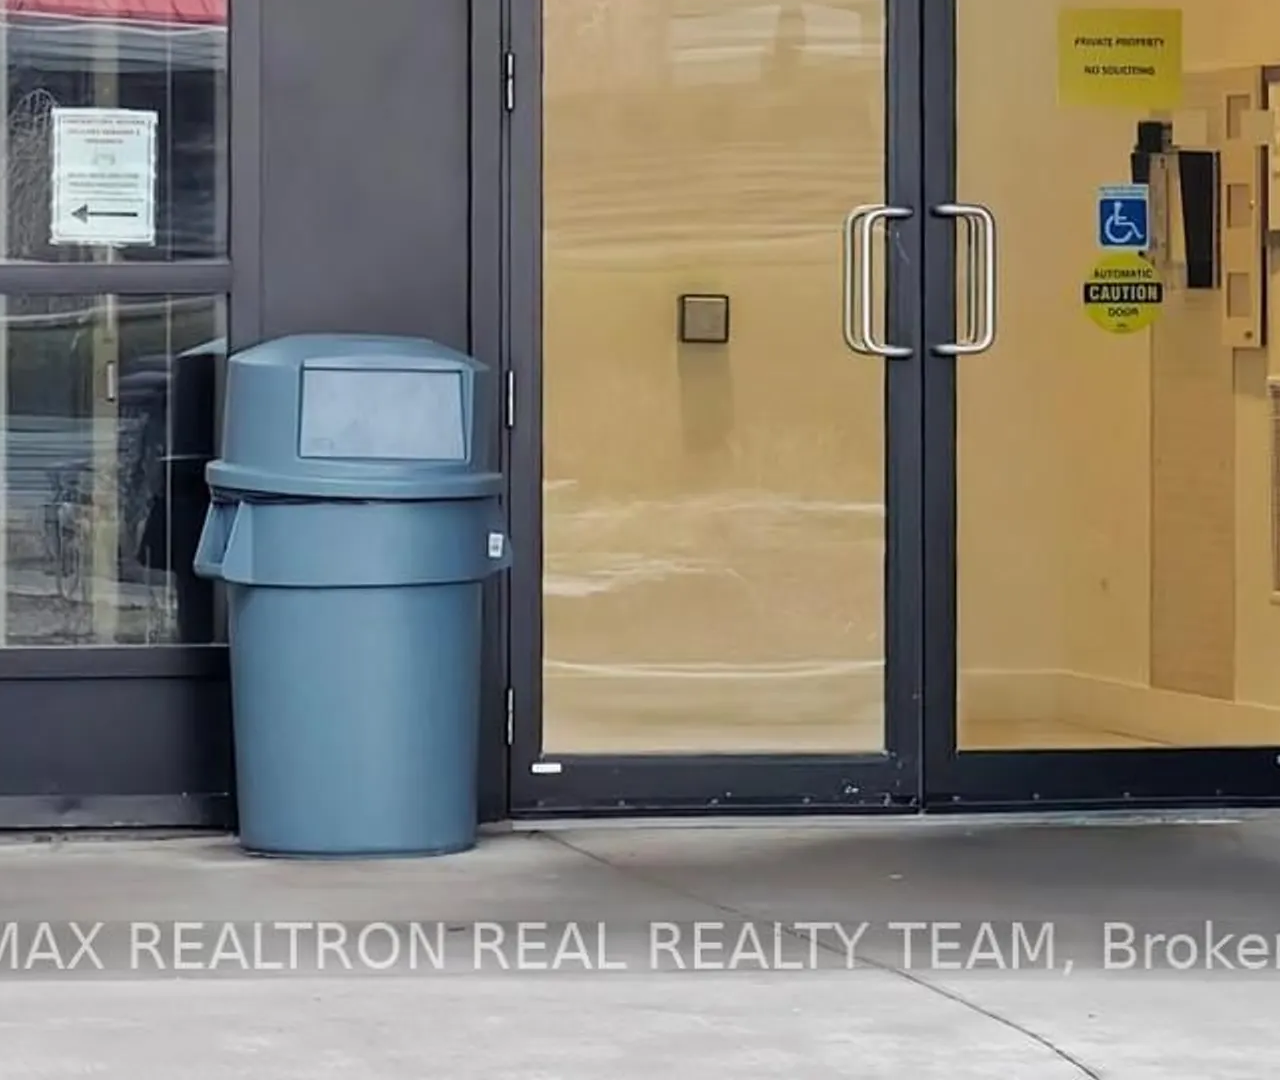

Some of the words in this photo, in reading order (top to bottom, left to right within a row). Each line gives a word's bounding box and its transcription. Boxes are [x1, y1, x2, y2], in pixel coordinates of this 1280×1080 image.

[1084, 65, 1100, 75] NO
[1094, 268, 1153, 279] AUTOMATIC
[1089, 285, 1158, 301] CAUTION
[1108, 307, 1139, 317] DOOR
